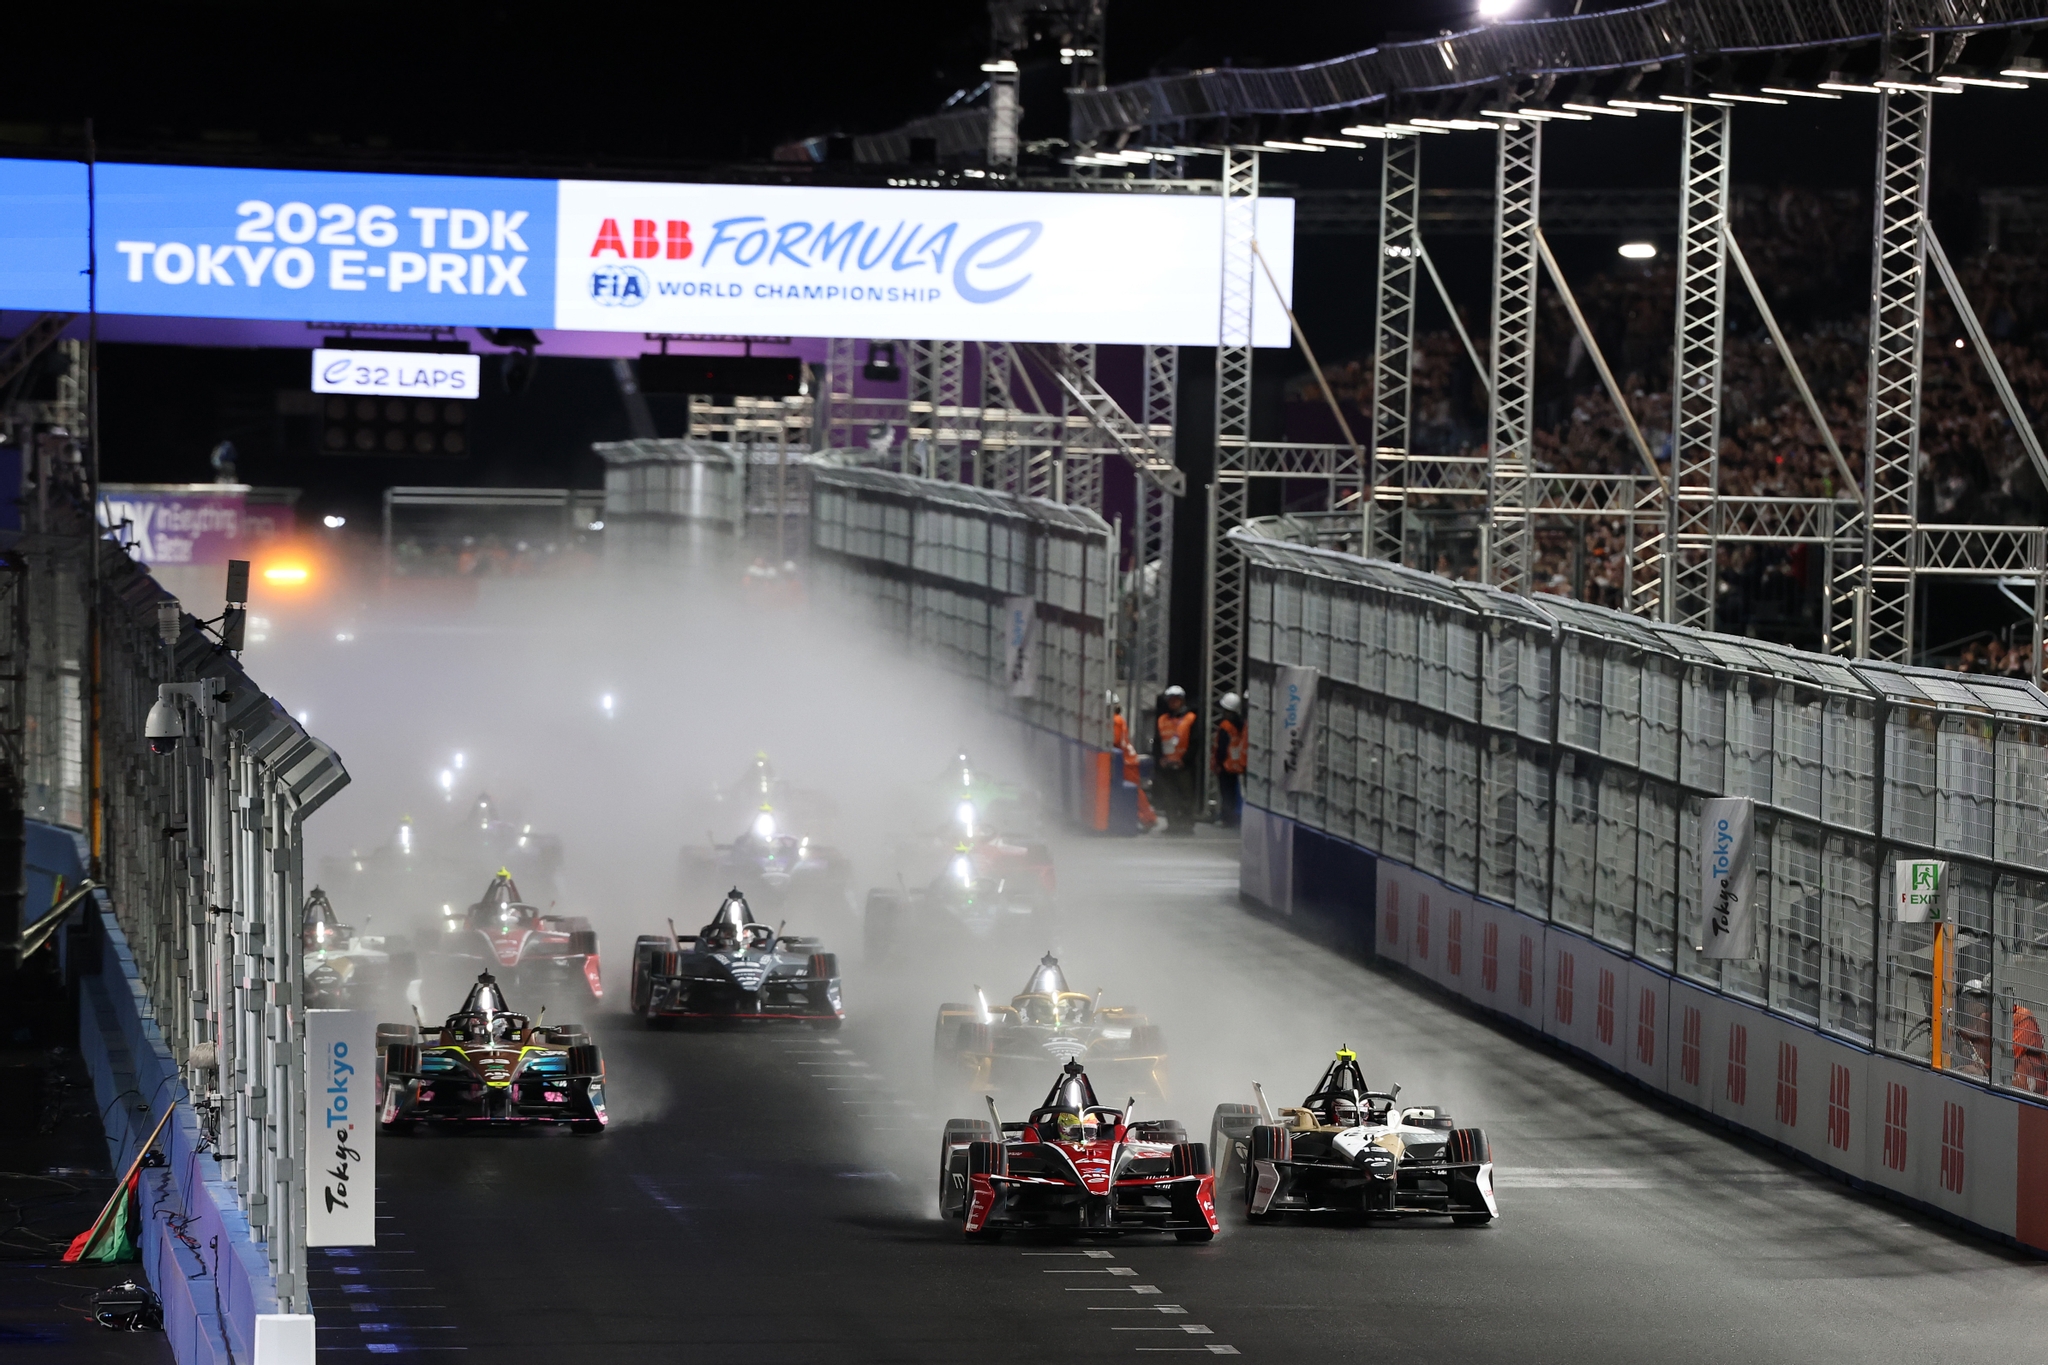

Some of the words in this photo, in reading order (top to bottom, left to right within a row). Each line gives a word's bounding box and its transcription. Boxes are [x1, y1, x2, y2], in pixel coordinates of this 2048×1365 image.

[235, 200, 398, 247] 2026
[409, 207, 529, 251] TDK
[590, 218, 693, 260] ABB
[702, 216, 958, 273] FORMULA
[116, 240, 316, 288] TOKYO
[329, 249, 529, 297] E-PRIX
[657, 280, 743, 298] WORLD
[754, 283, 941, 302] CHAMPIONSHIP
[355, 366, 389, 386] 32
[399, 368, 466, 389] LAPS
[1284, 684, 1302, 729] Tokyo
[1713, 819, 1734, 879] Tokyo
[1712, 879, 1739, 937] Tokyo
[1910, 894, 1940, 904] EXIT
[1596, 966, 1614, 1046] ABB
[1636, 986, 1655, 1067] ABB
[1681, 1005, 1700, 1087] ABB
[326, 1041, 354, 1129] Tokyo
[1726, 1022, 1747, 1107] ABB
[1775, 1040, 1798, 1128] ABB
[1828, 1062, 1850, 1152] ABB
[1883, 1081, 1907, 1172] ABB
[325, 1127, 361, 1215] Tokyo
[1940, 1100, 1965, 1195] ABB
